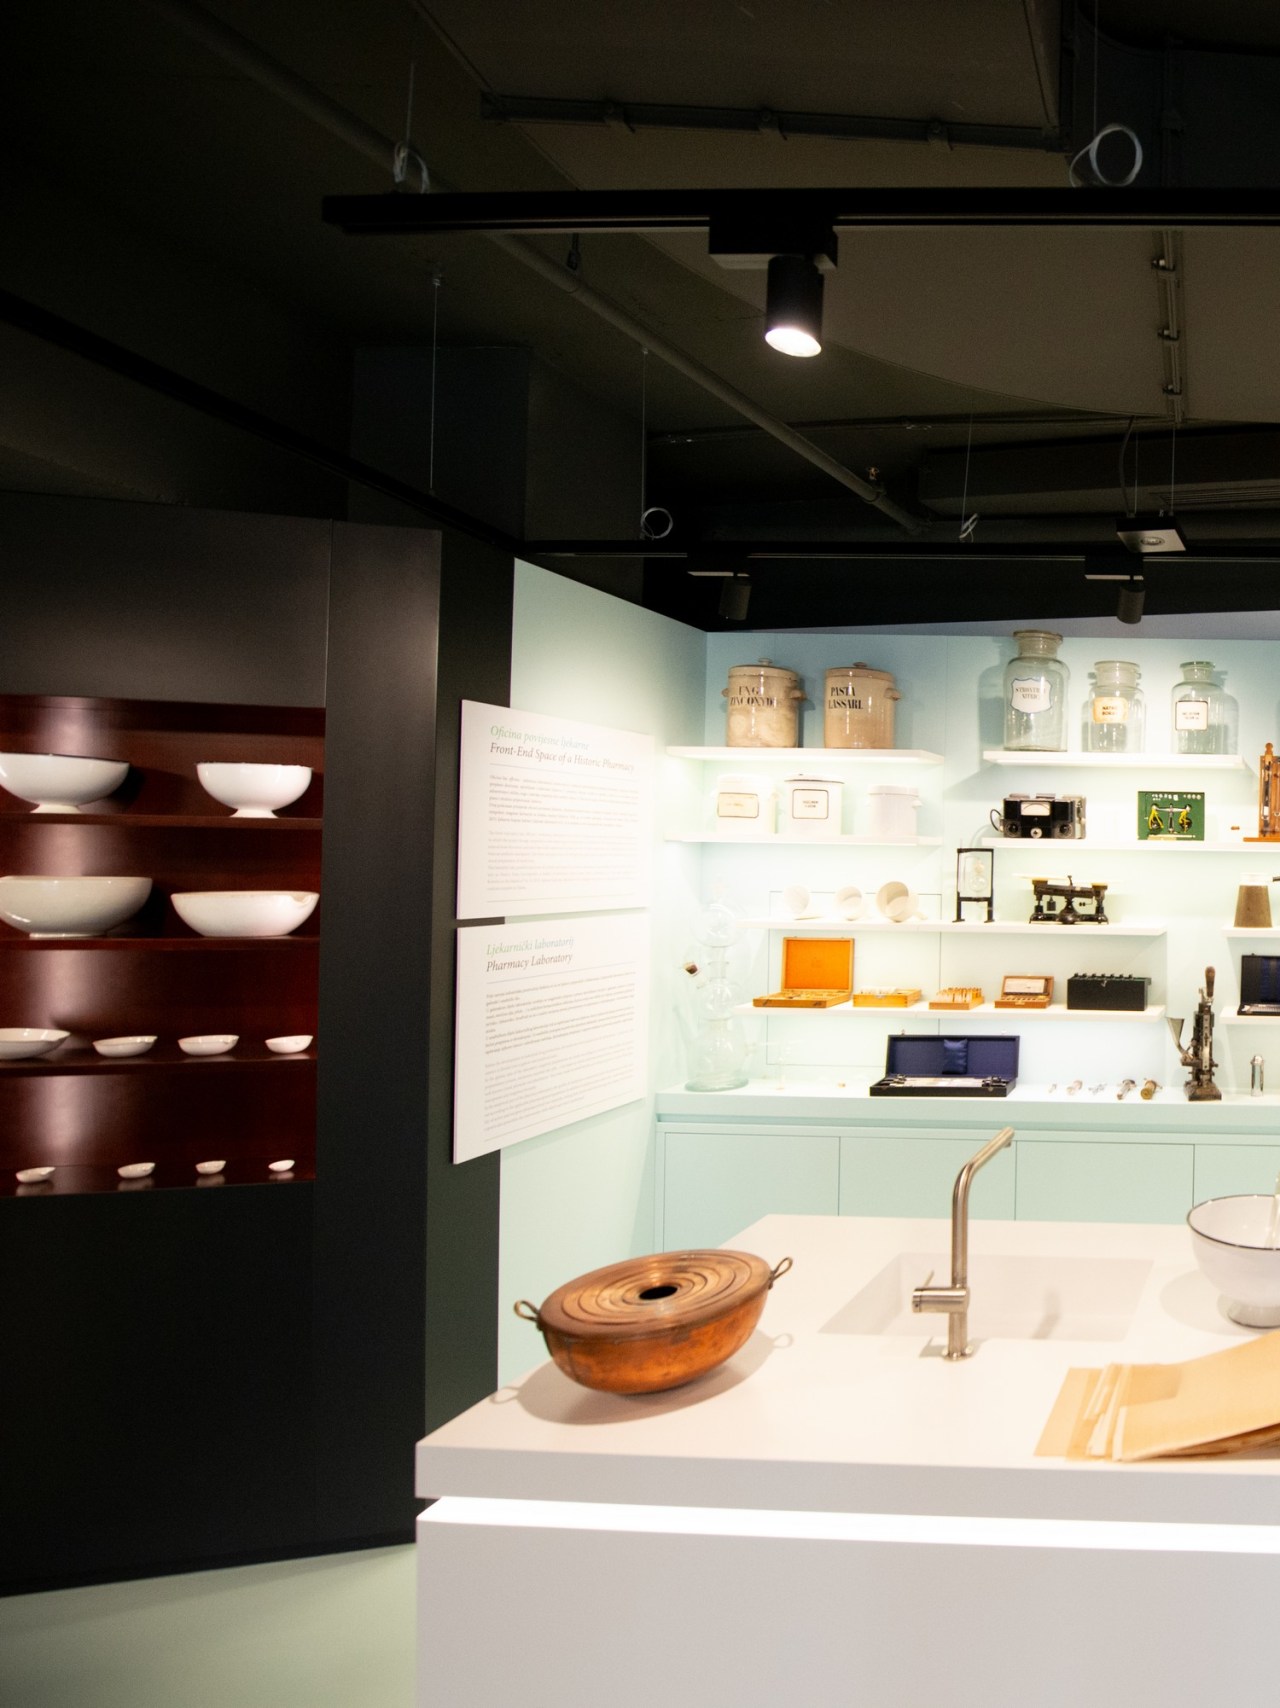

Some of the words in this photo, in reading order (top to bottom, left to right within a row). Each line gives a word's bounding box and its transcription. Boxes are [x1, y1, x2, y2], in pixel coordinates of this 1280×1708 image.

[830, 686, 856, 697] PASTA
[490, 724, 522, 741] Oficina
[523, 734, 560, 747] povijesne
[489, 742, 534, 758] Front-End
[534, 750, 557, 762] Space
[557, 752, 567, 765] of
[573, 755, 601, 767] Historic
[601, 759, 635, 774] Pharmacy
[486, 940, 533, 958] Ljekarnički
[534, 936, 575, 950] laboratorij
[486, 958, 529, 973] Pharmacy
[530, 953, 573, 967] Laboratory
